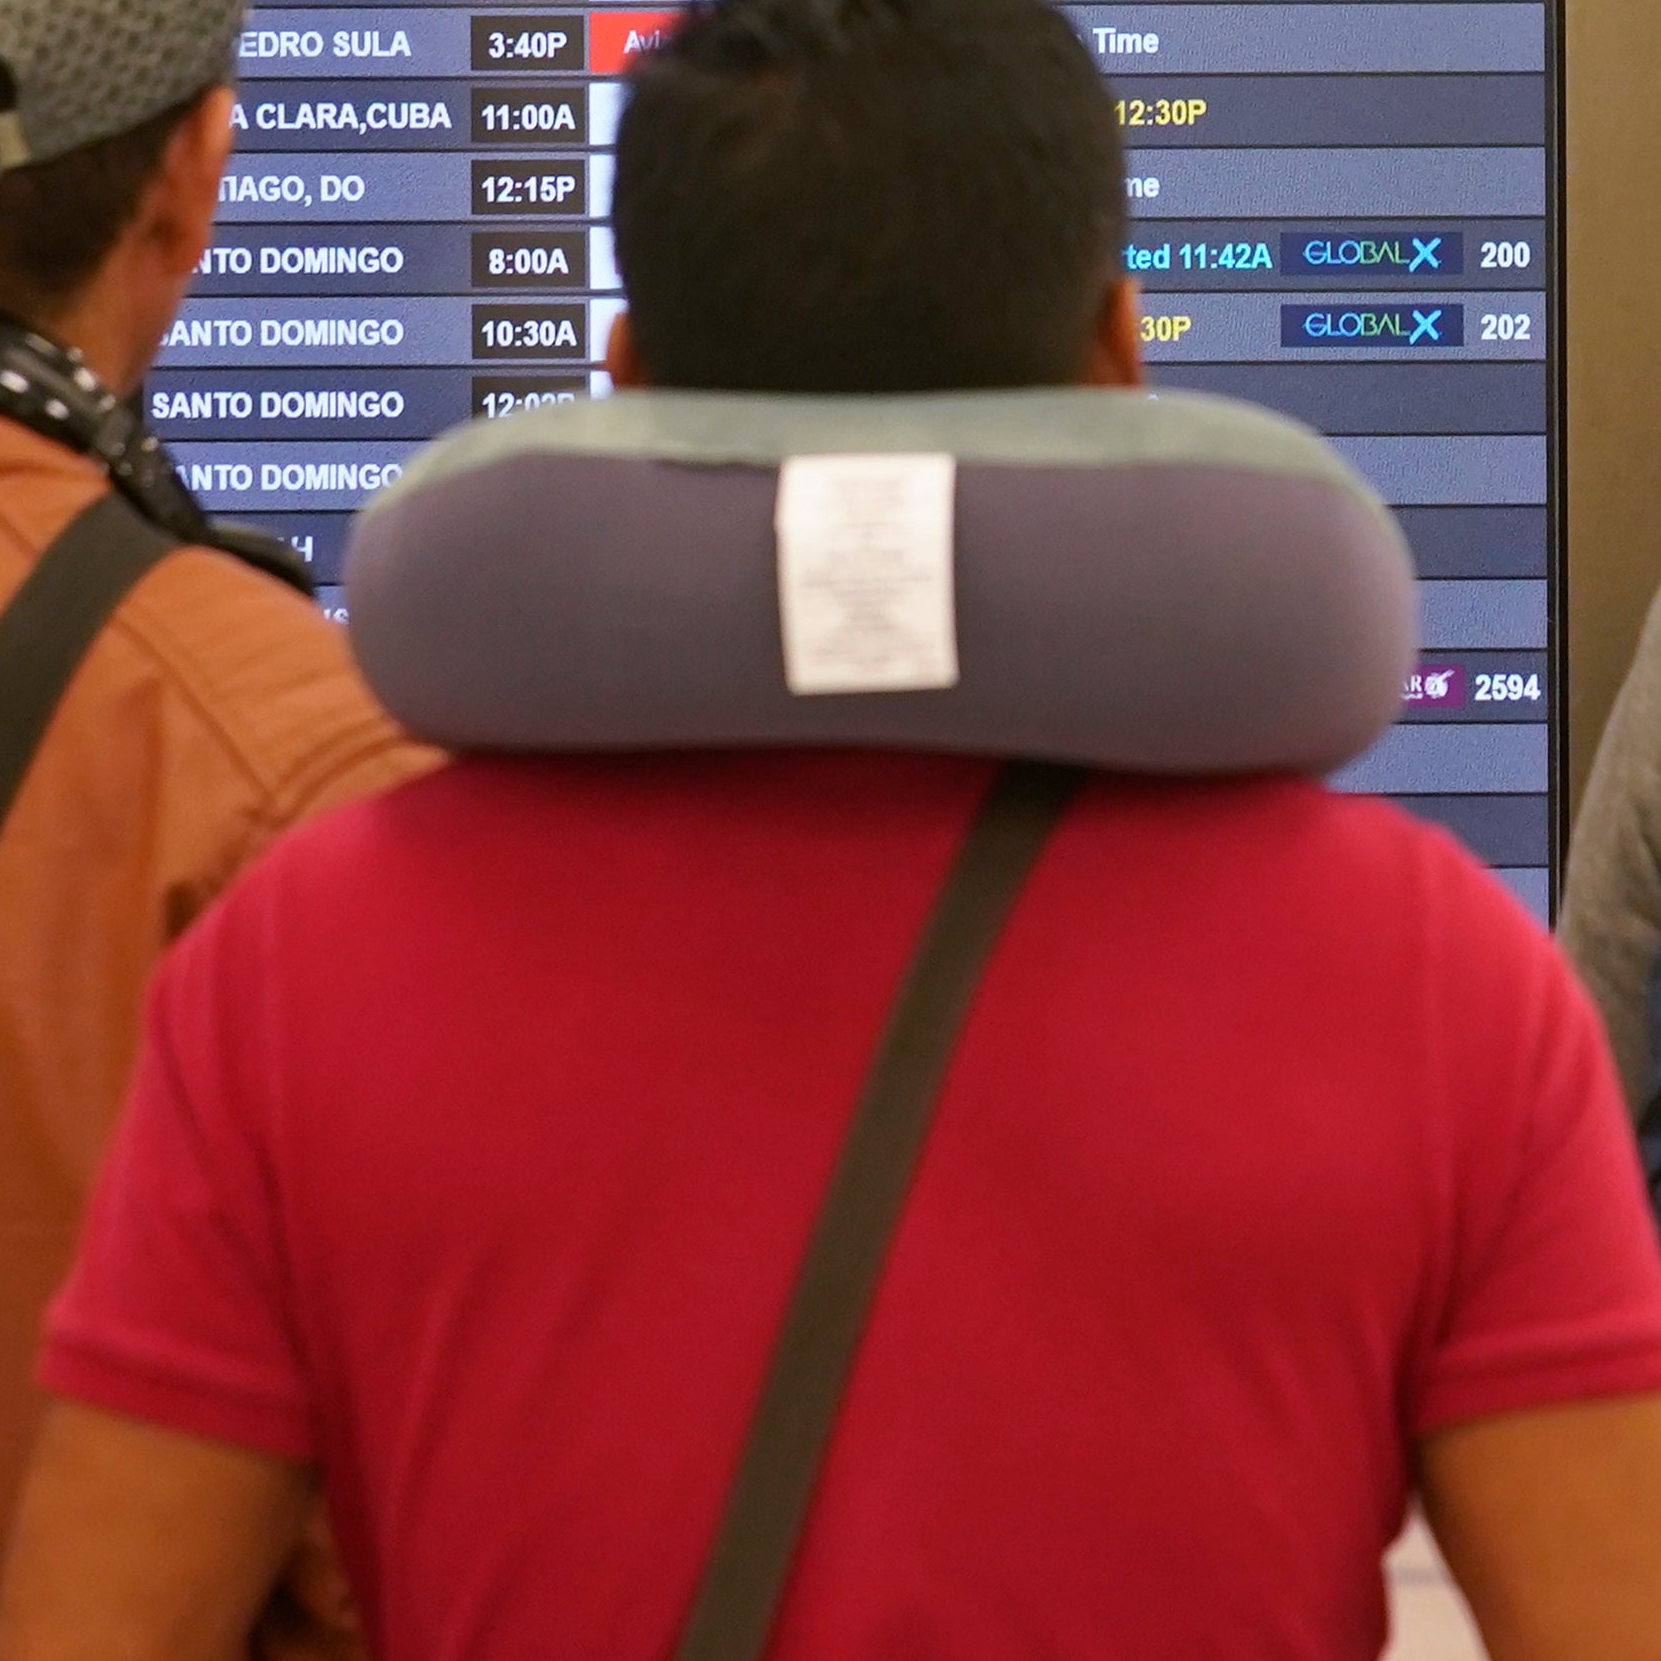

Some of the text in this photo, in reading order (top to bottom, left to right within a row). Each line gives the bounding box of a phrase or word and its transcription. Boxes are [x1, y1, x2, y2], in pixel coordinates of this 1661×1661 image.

[256, 103, 451, 134] CLARA,CUBA
[1180, 243, 1272, 269] 11:42A
[152, 392, 404, 418] SANTO DOMINGO
[1475, 674, 1541, 700] 2594
